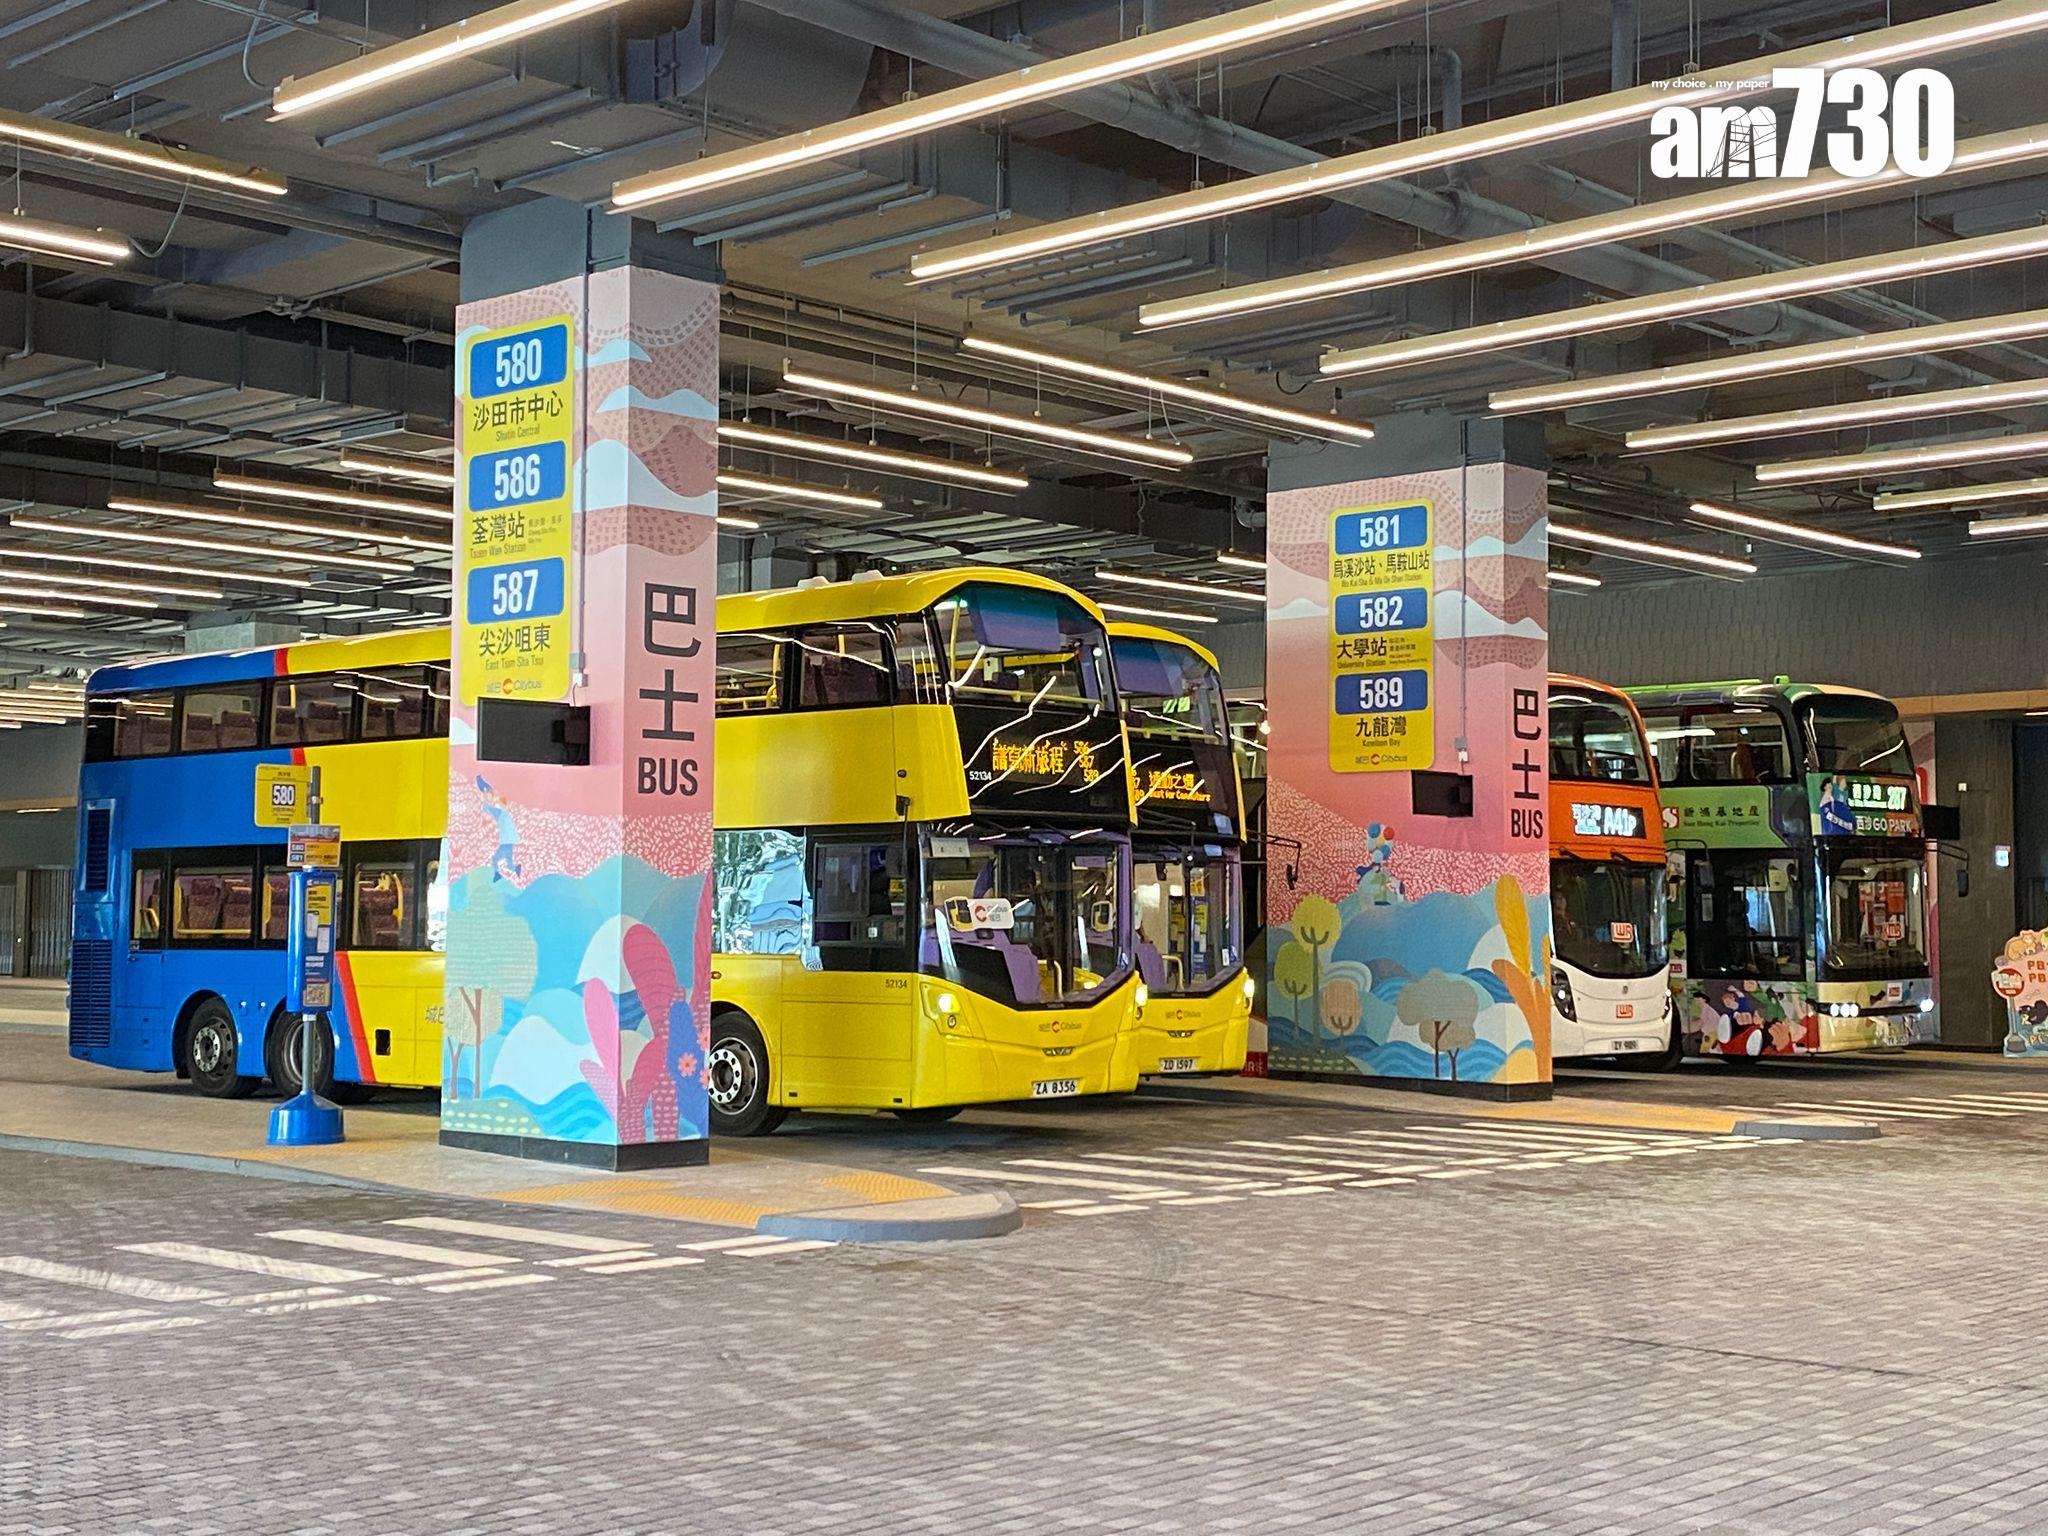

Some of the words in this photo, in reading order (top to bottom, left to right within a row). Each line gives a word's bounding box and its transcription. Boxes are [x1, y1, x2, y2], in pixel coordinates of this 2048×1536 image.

[495, 338, 543, 388] 580
[473, 390, 563, 431] 沙田市中心
[517, 424, 540, 439] Central
[494, 453, 541, 502] 586
[472, 511, 525, 545] 荃灣站
[1359, 514, 1400, 548] 581
[489, 546, 502, 556] Wan
[504, 543, 526, 554] Station
[492, 569, 538, 616] 587
[1359, 596, 1403, 629] 582
[479, 622, 551, 657] 尖沙咀東
[1336, 637, 1387, 660] 大學站
[485, 659, 499, 671] East
[517, 657, 529, 667] Sha
[639, 582, 702, 742] 巴士
[1337, 660, 1364, 669] University
[1366, 659, 1386, 667] Station
[1359, 677, 1403, 710] 589
[1355, 715, 1407, 737] 九龍灣
[1362, 739, 1388, 747] Kowloon
[1389, 738, 1400, 747] Bay
[1512, 688, 1542, 800] 巴士
[638, 757, 698, 796] BUS
[969, 770, 992, 781] 52134
[273, 785, 295, 805] 580
[1511, 808, 1543, 839] BUS
[1889, 819, 1913, 833] PARK
[885, 978, 908, 989] 52134
[1176, 1058, 1193, 1070] 1597
[1036, 1083, 1048, 1095] ZA
[1052, 1080, 1076, 1093] 8356
